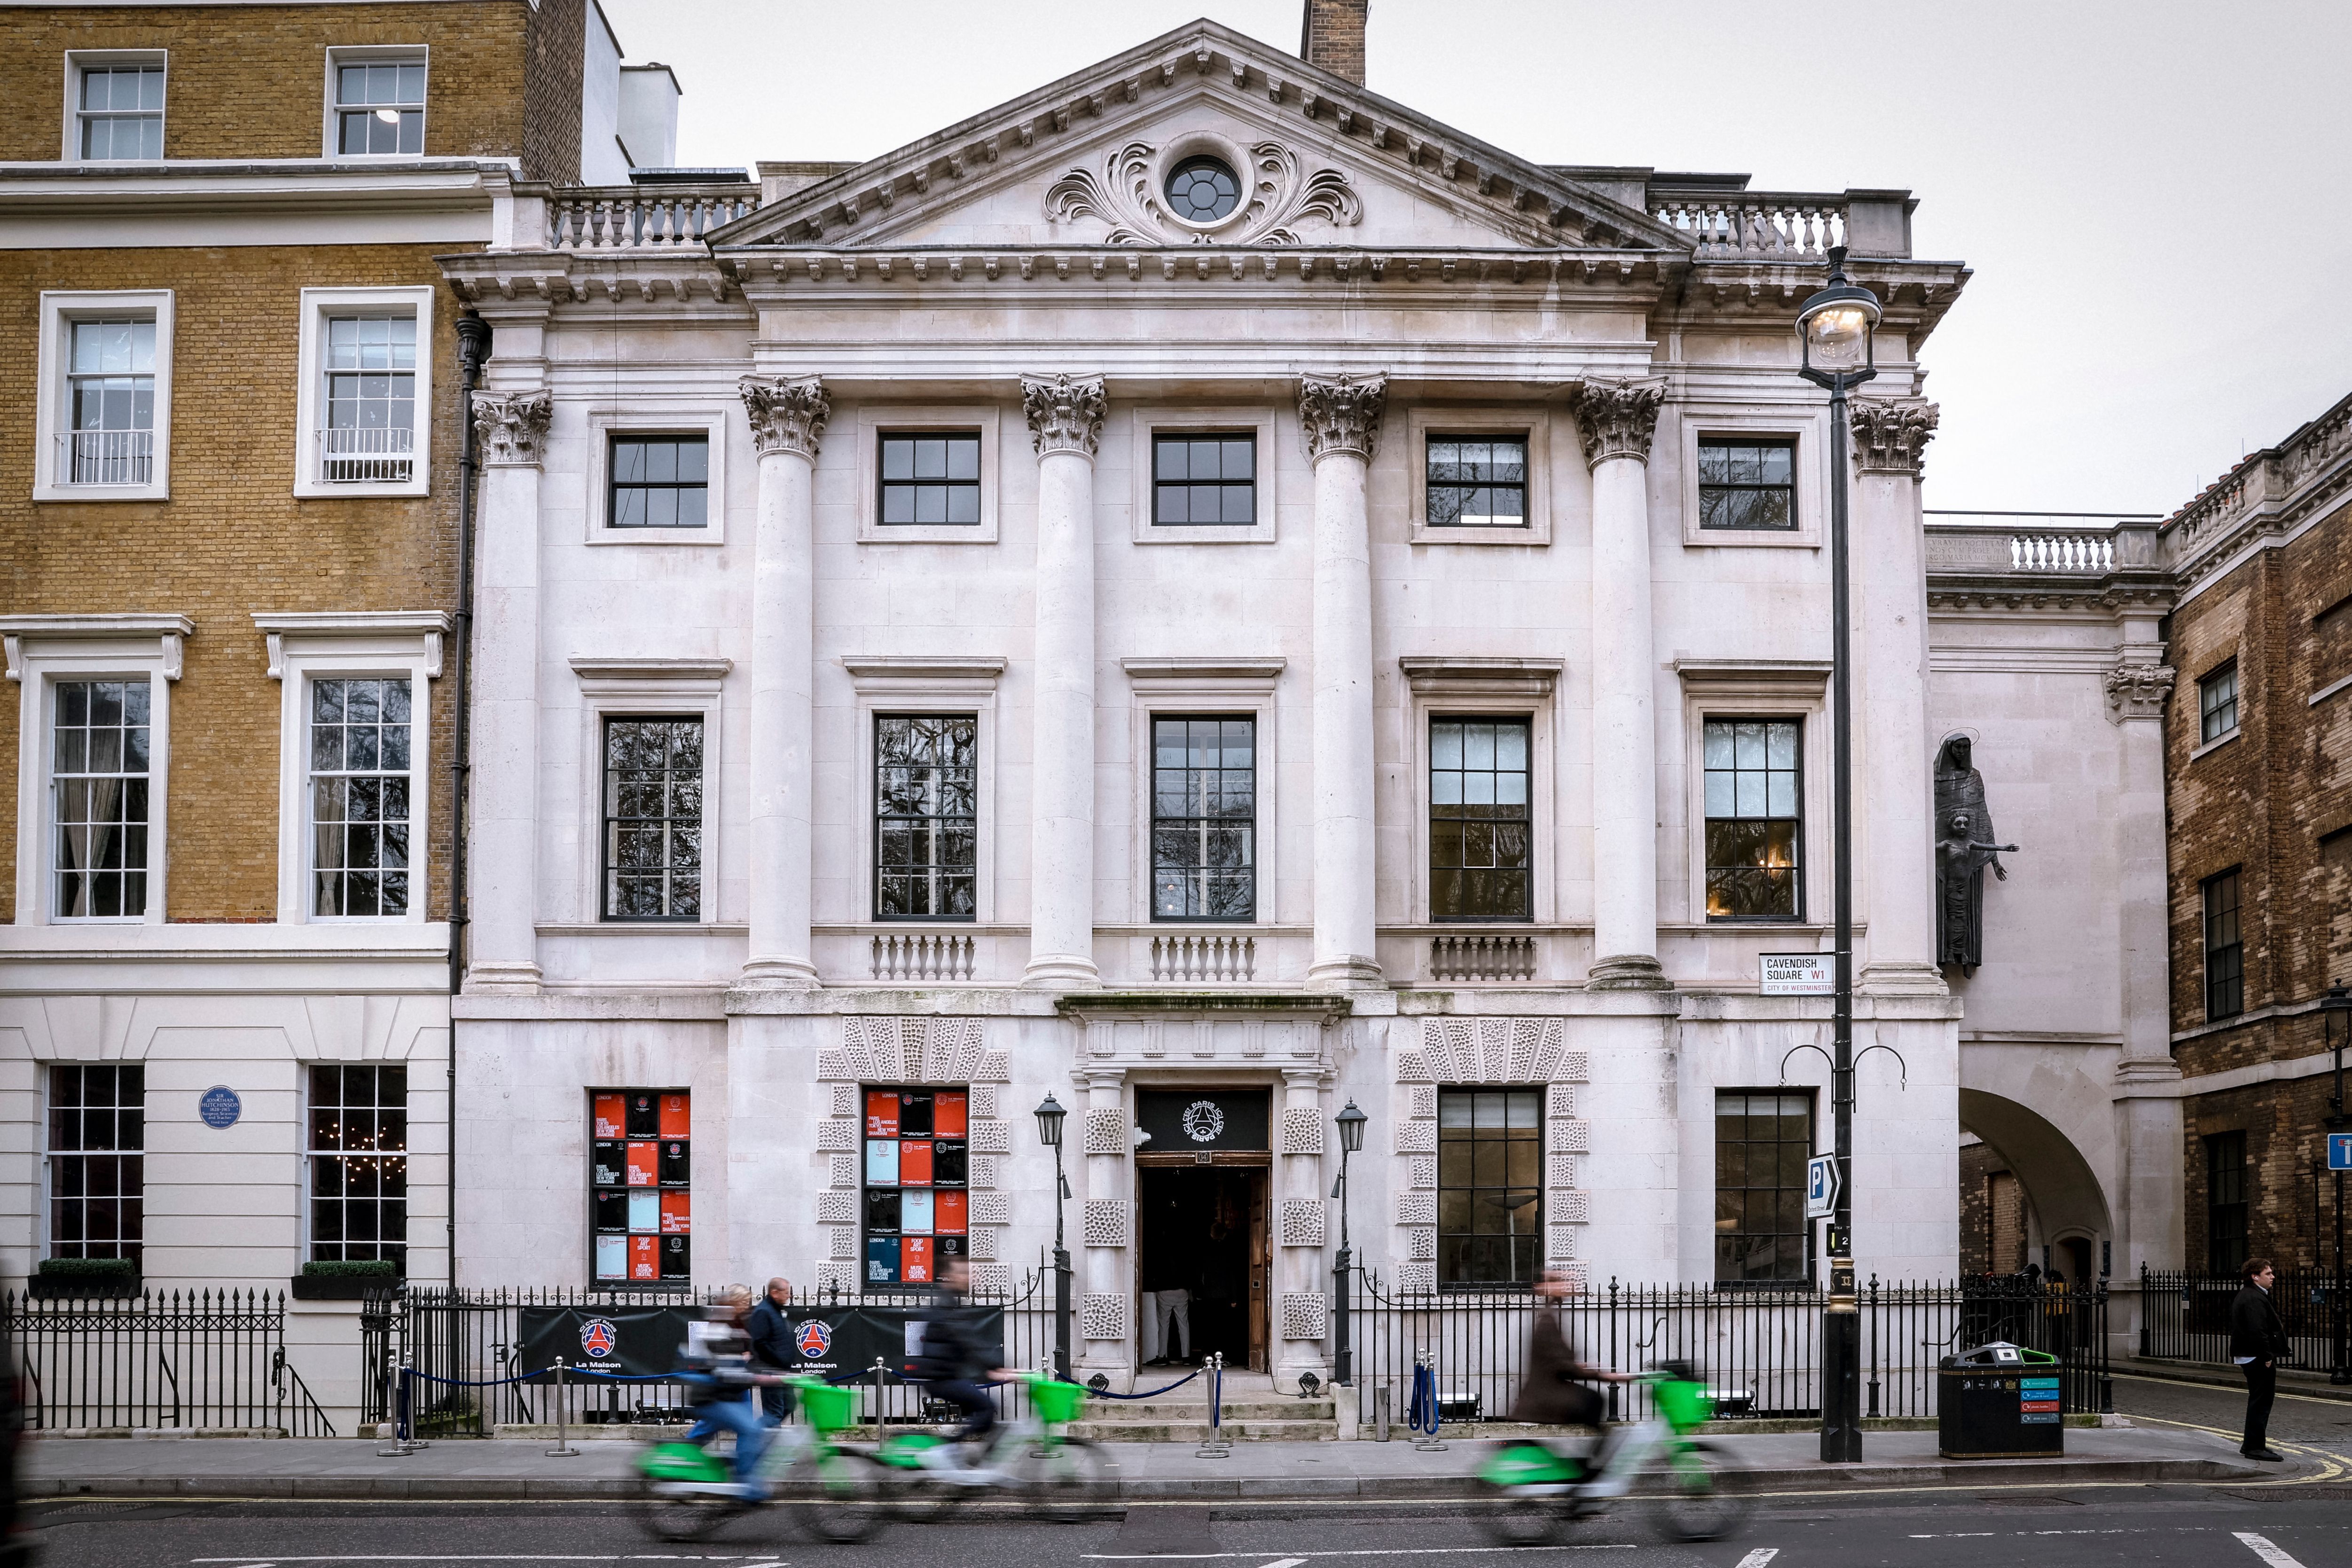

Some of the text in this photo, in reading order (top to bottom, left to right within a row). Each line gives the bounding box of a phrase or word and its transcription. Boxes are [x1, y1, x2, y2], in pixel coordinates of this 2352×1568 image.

[1767, 959, 1817, 968] CAVENDISH
[1767, 970, 1824, 980] SQUARE W1
[1182, 1107, 1191, 1121] C'EST
[1183, 1124, 1192, 1135] ICI
[1191, 1107, 1224, 1142] ICI C'EST PARIS
[1812, 1166, 1821, 1196] P
[1842, 1237, 1848, 1245] 2
[603, 1320, 617, 1333] PARIS
[818, 1320, 832, 1333] PARIS
